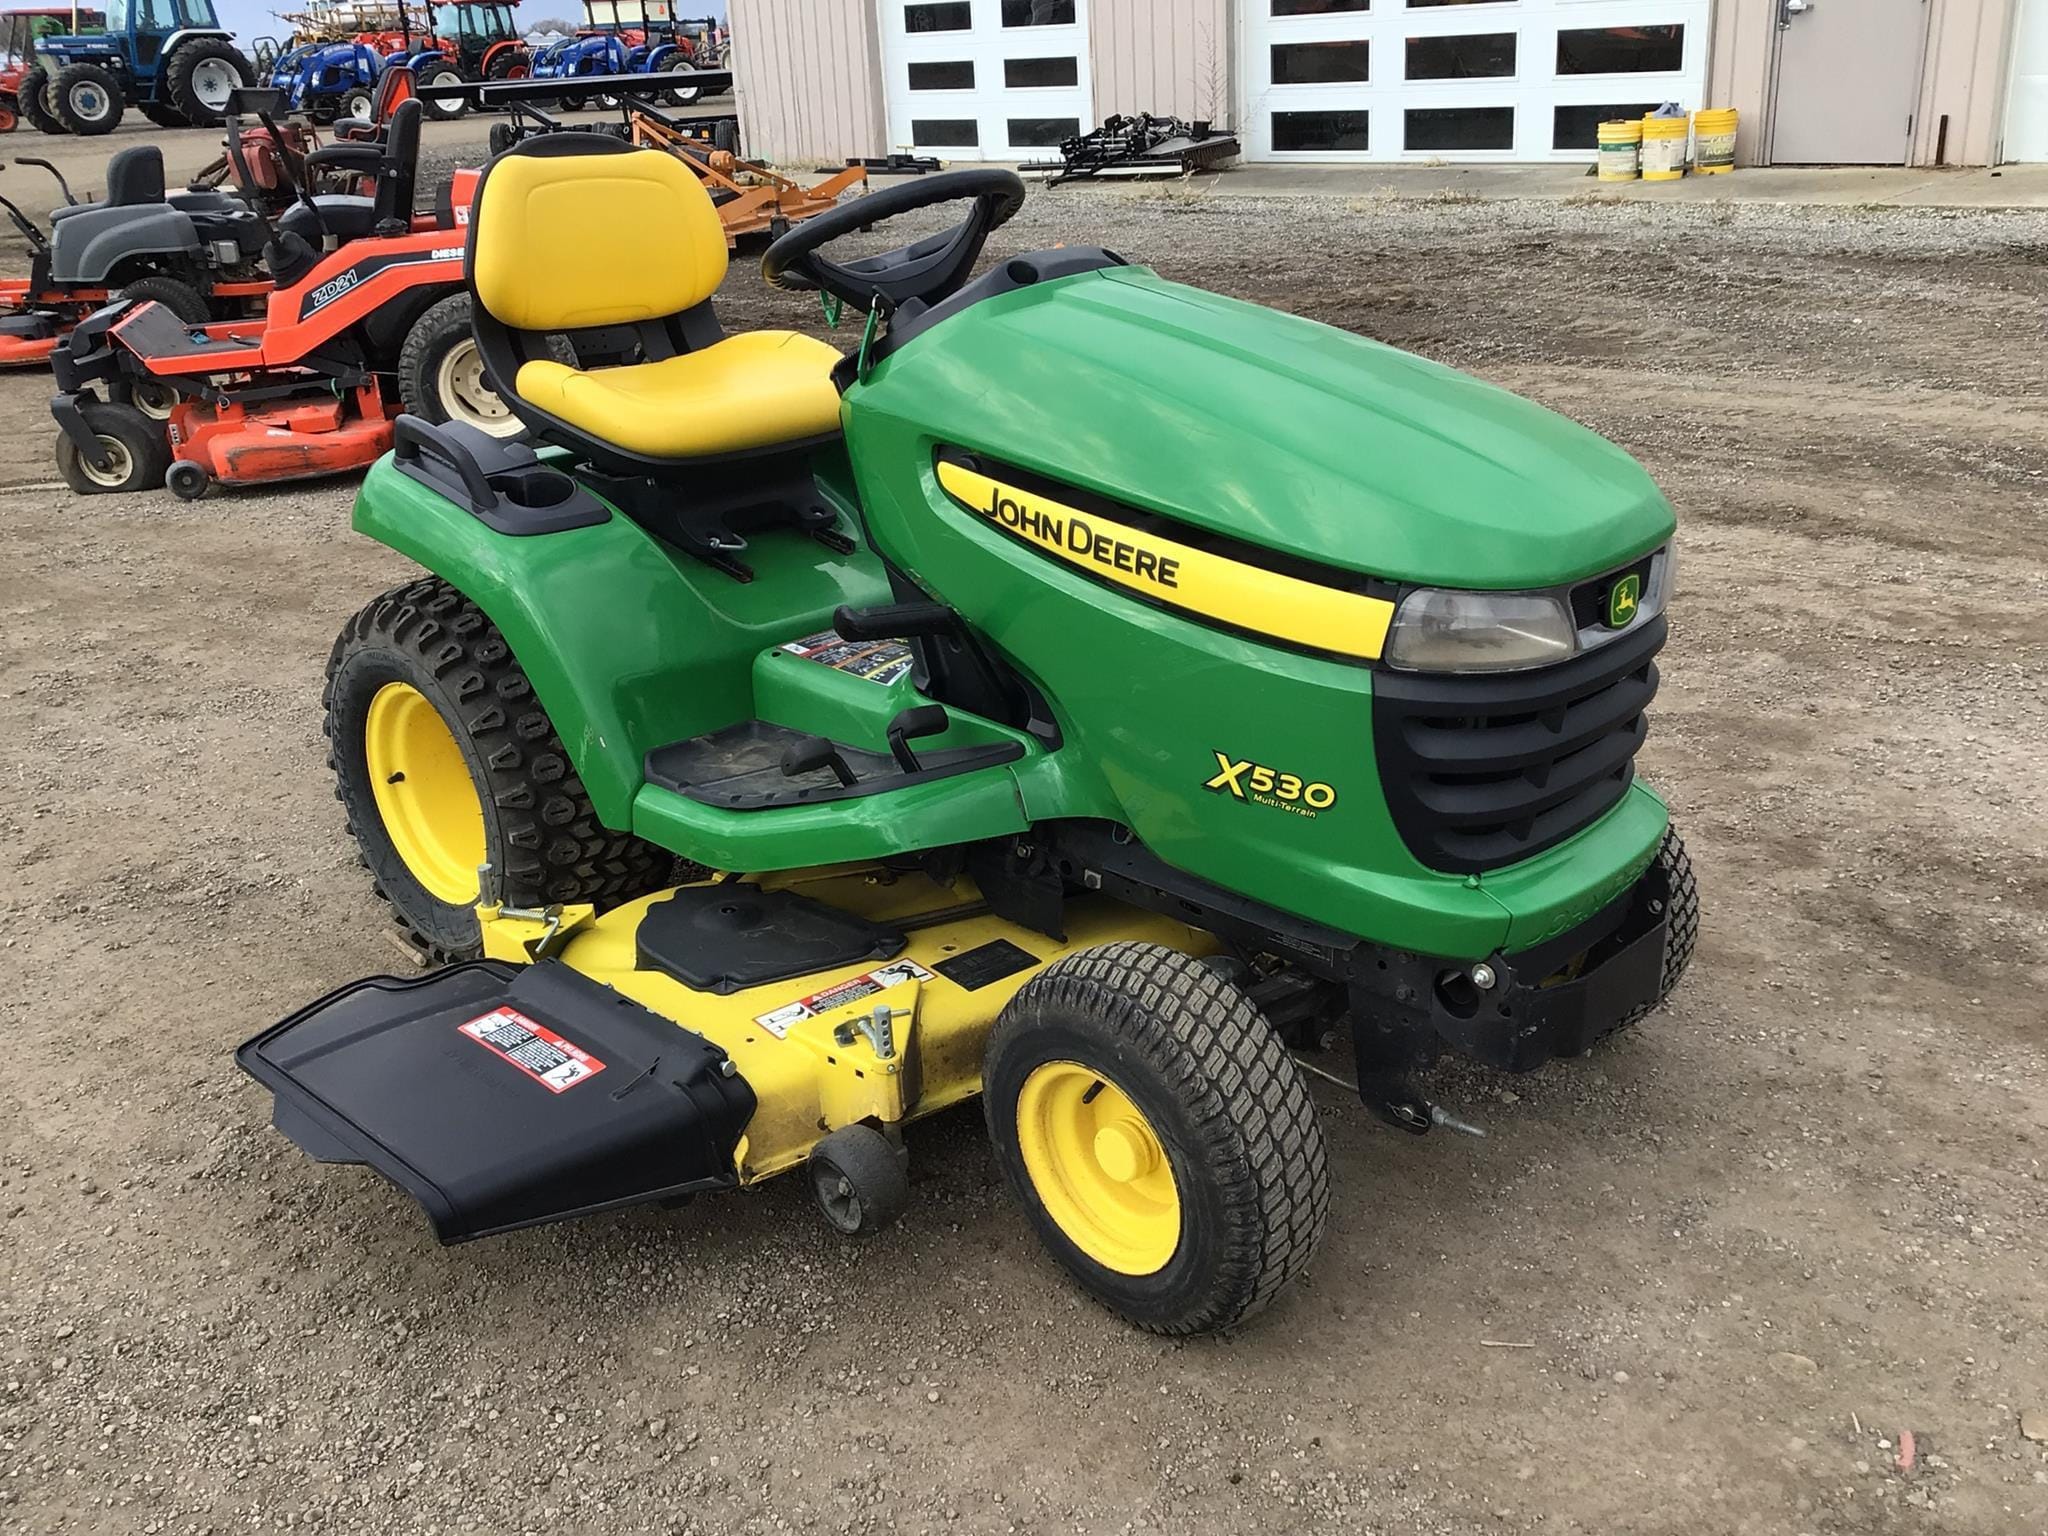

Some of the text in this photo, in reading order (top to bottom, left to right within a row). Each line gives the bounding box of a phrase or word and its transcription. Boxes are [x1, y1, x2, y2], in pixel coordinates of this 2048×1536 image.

[431, 247, 465, 259] DIESE
[311, 268, 358, 307] ZD21
[983, 488, 1180, 588] JOHN DEERE
[1201, 749, 1337, 810] X530
[1253, 793, 1318, 819] Multi-Terrain
[820, 978, 863, 997] DANGER
